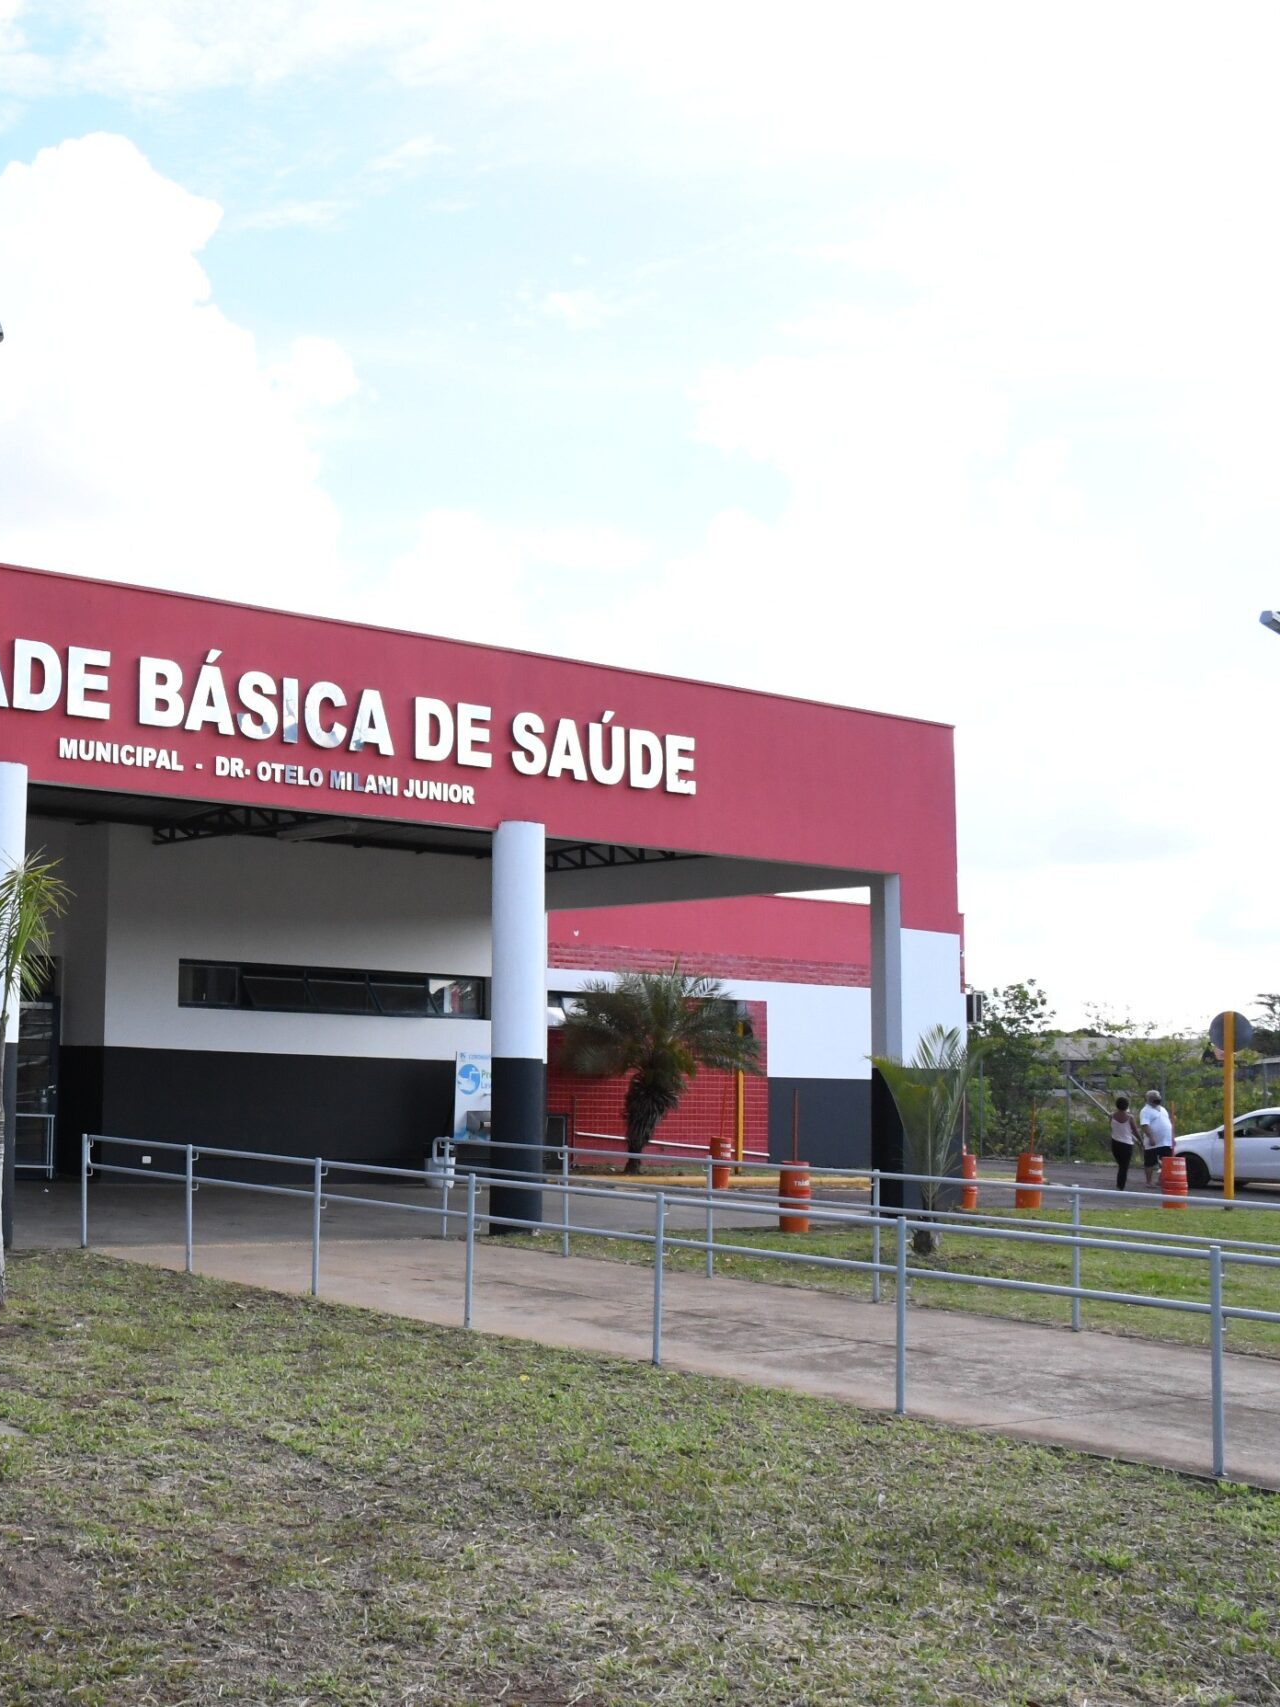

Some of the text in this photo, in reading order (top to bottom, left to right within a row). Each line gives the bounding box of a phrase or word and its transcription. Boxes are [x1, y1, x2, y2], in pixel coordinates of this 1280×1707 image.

[58, 737, 185, 772] MUNICIPAL
[215, 755, 251, 778] DR.
[256, 760, 323, 787] OTELO
[329, 769, 399, 796] MILANI
[403, 778, 476, 805] JUNIOR
[138, 648, 395, 756] BÁSICA
[415, 696, 493, 768] DE
[511, 710, 696, 795] SAÚDE
